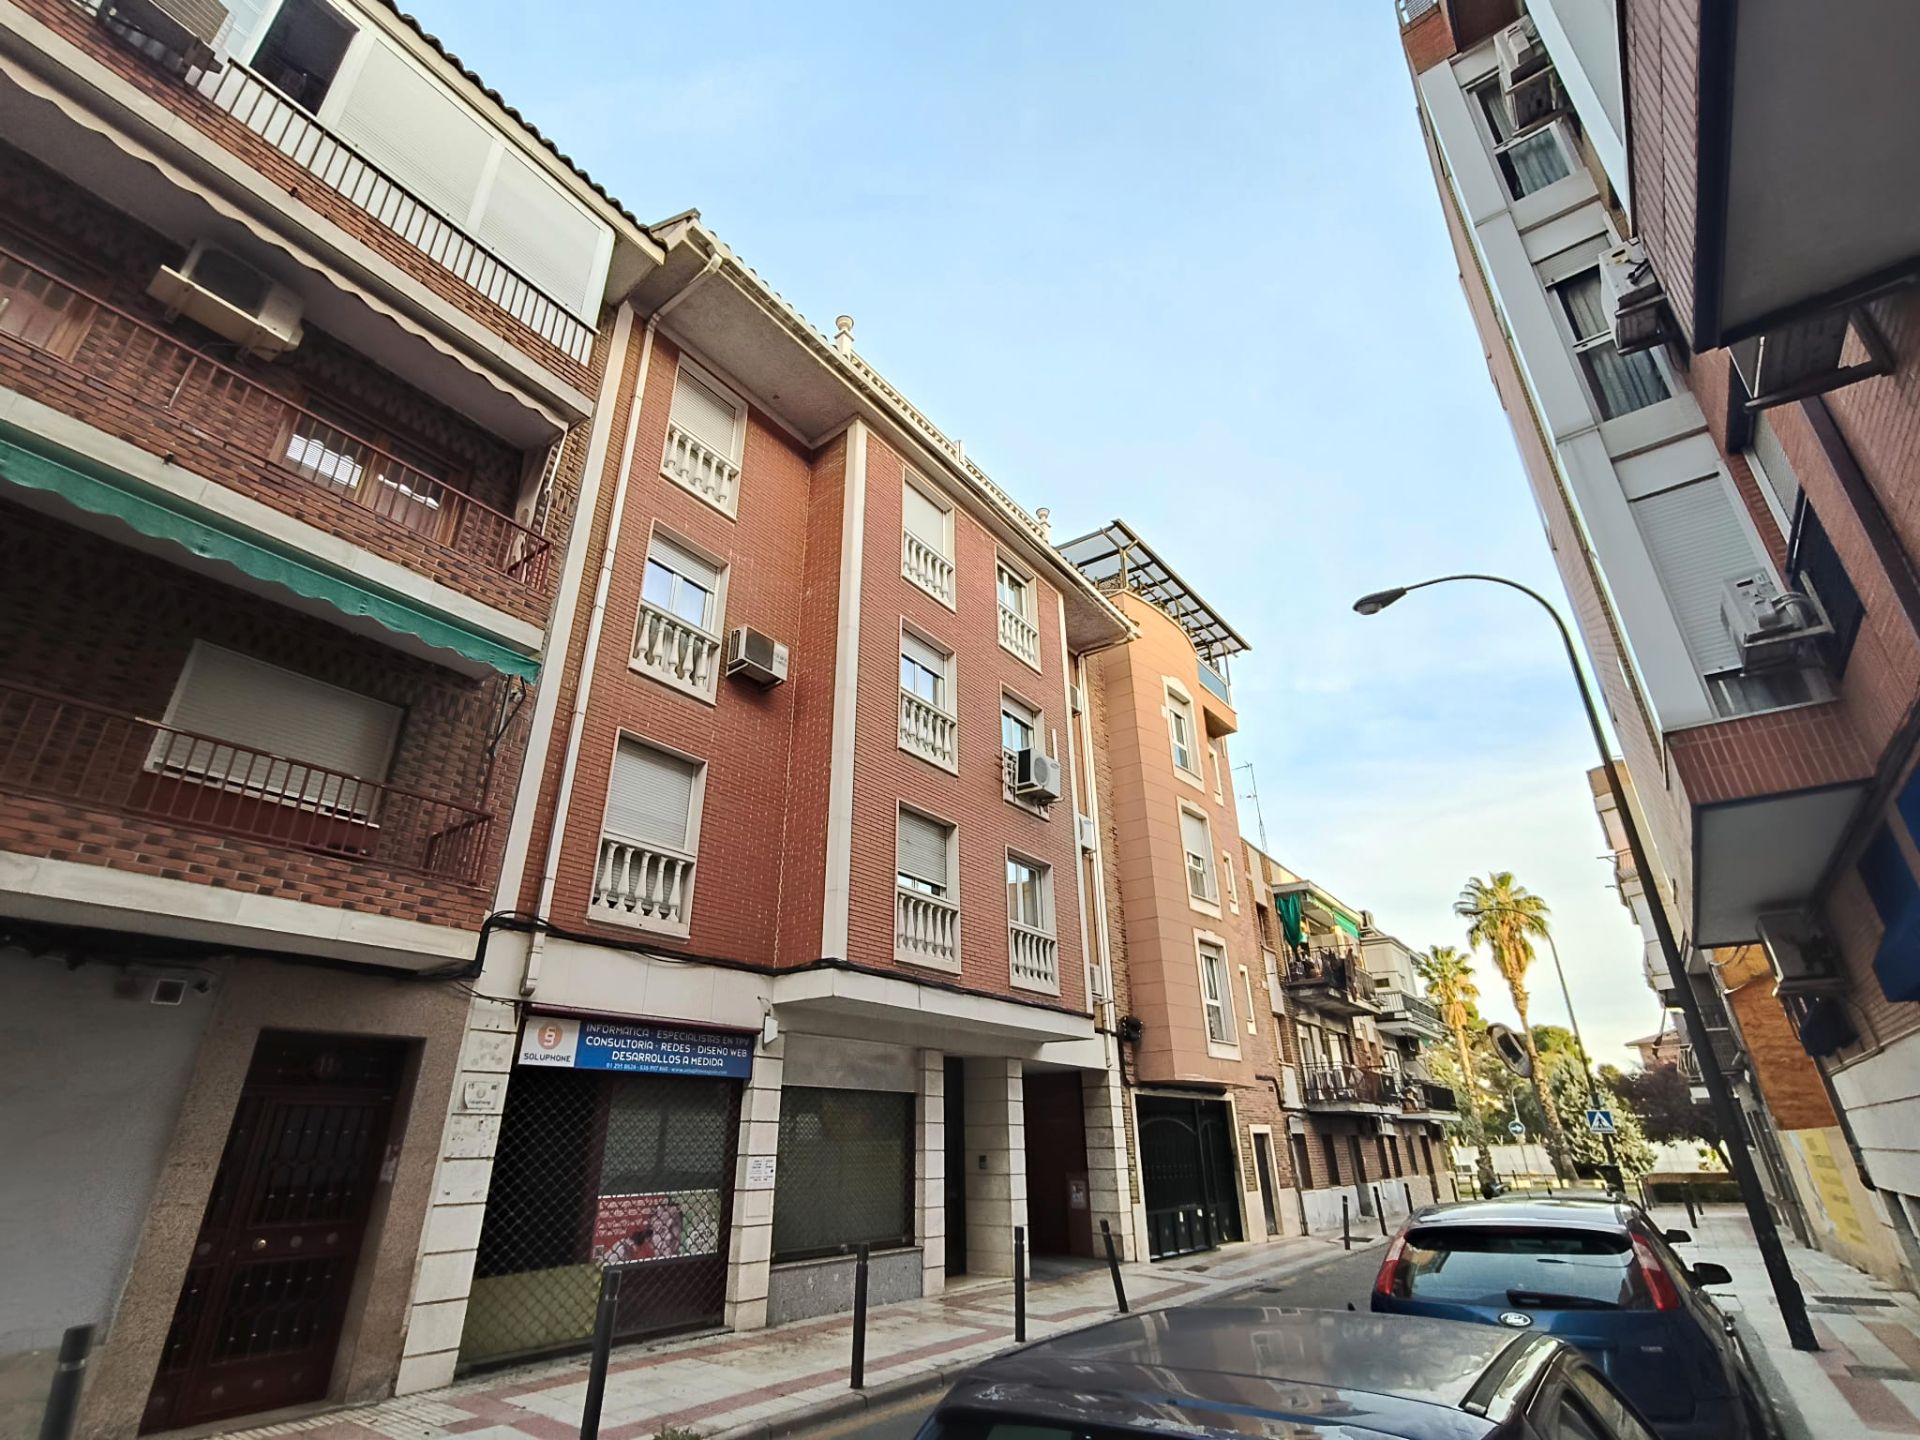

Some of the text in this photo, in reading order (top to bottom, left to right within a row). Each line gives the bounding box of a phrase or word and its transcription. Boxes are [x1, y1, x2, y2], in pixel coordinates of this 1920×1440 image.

[660, 1043, 691, 1053] REDES
[730, 1048, 748, 1057] WEB
[524, 1053, 571, 1062] SOLUPHONE
[612, 1051, 724, 1067] DESARROLLOS A MEDIDA
